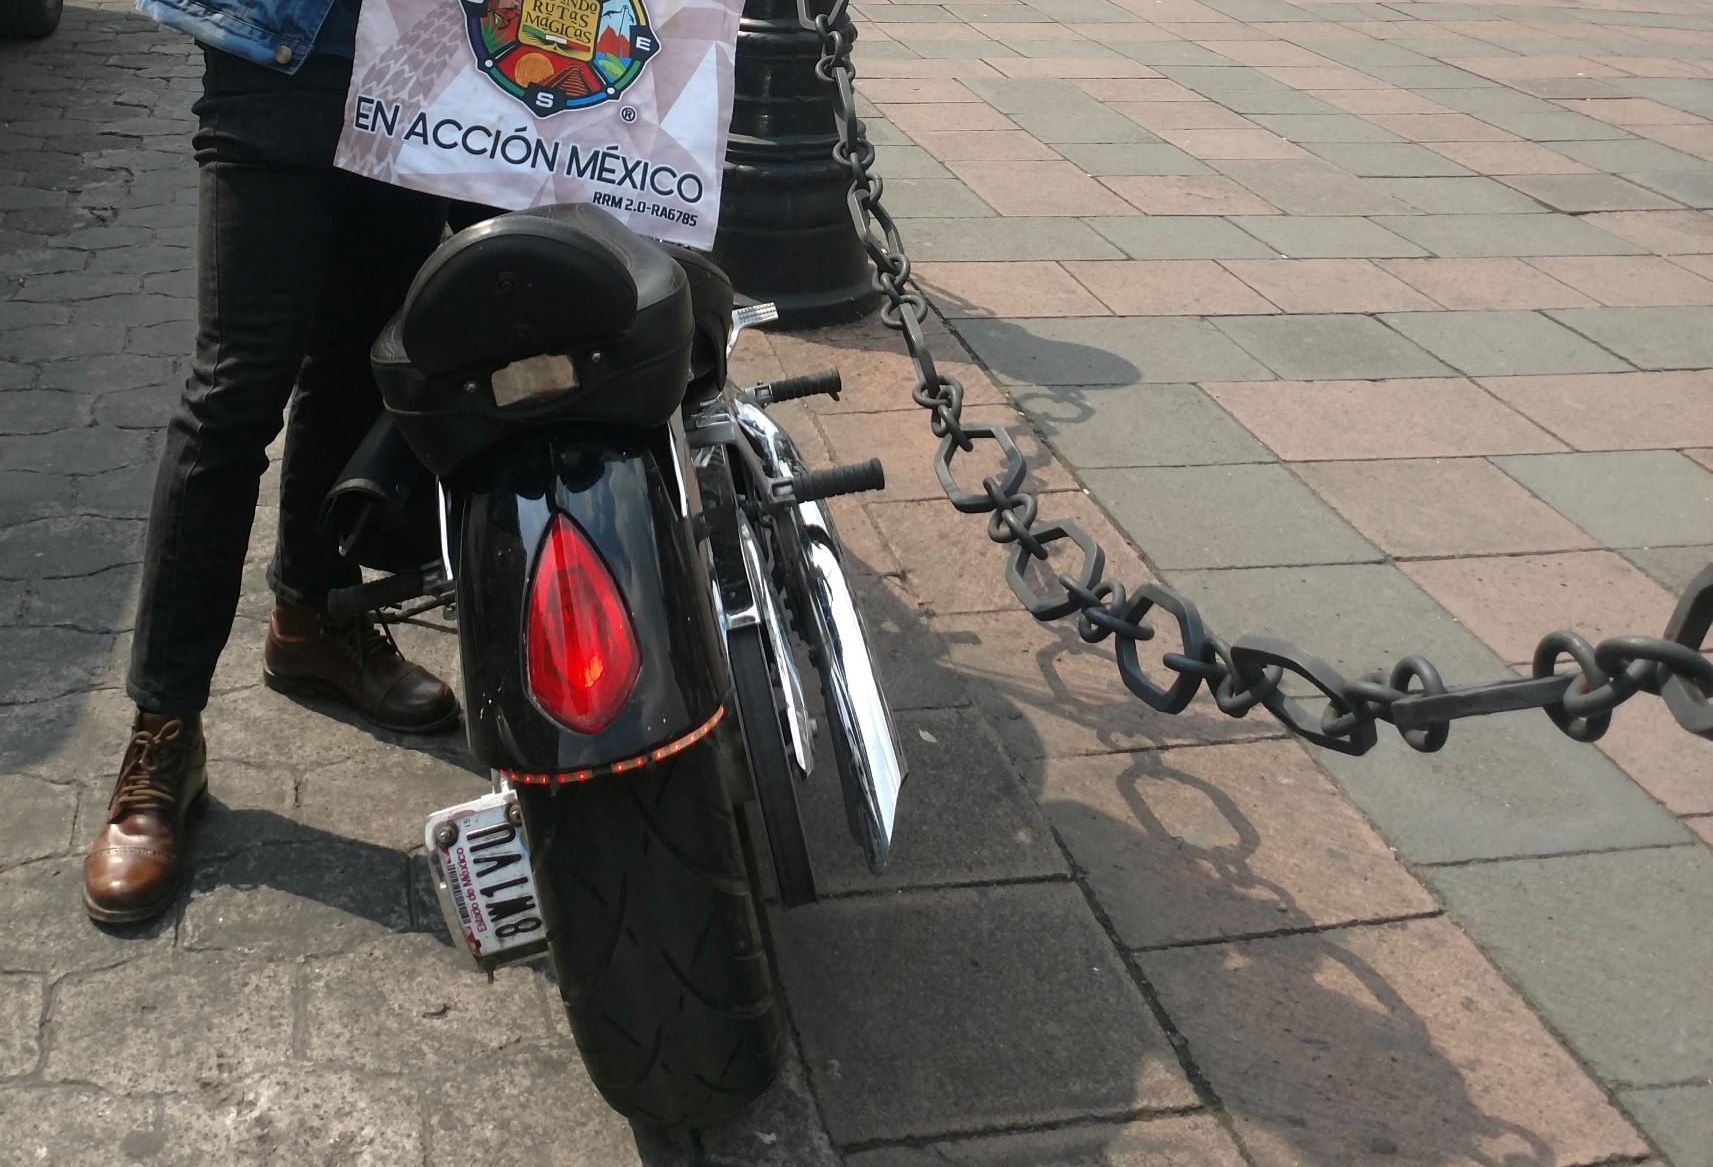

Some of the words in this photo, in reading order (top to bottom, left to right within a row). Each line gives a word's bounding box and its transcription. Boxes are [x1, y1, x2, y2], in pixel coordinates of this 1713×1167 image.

[636, 36, 651, 52] E
[535, 92, 555, 108] S
[354, 96, 401, 138] EN
[403, 113, 561, 173] ACCIÓN
[566, 140, 703, 204] MÉXICO
[592, 191, 624, 211] RRM
[466, 822, 543, 938] 8W1VU
[471, 901, 488, 933] Estado
